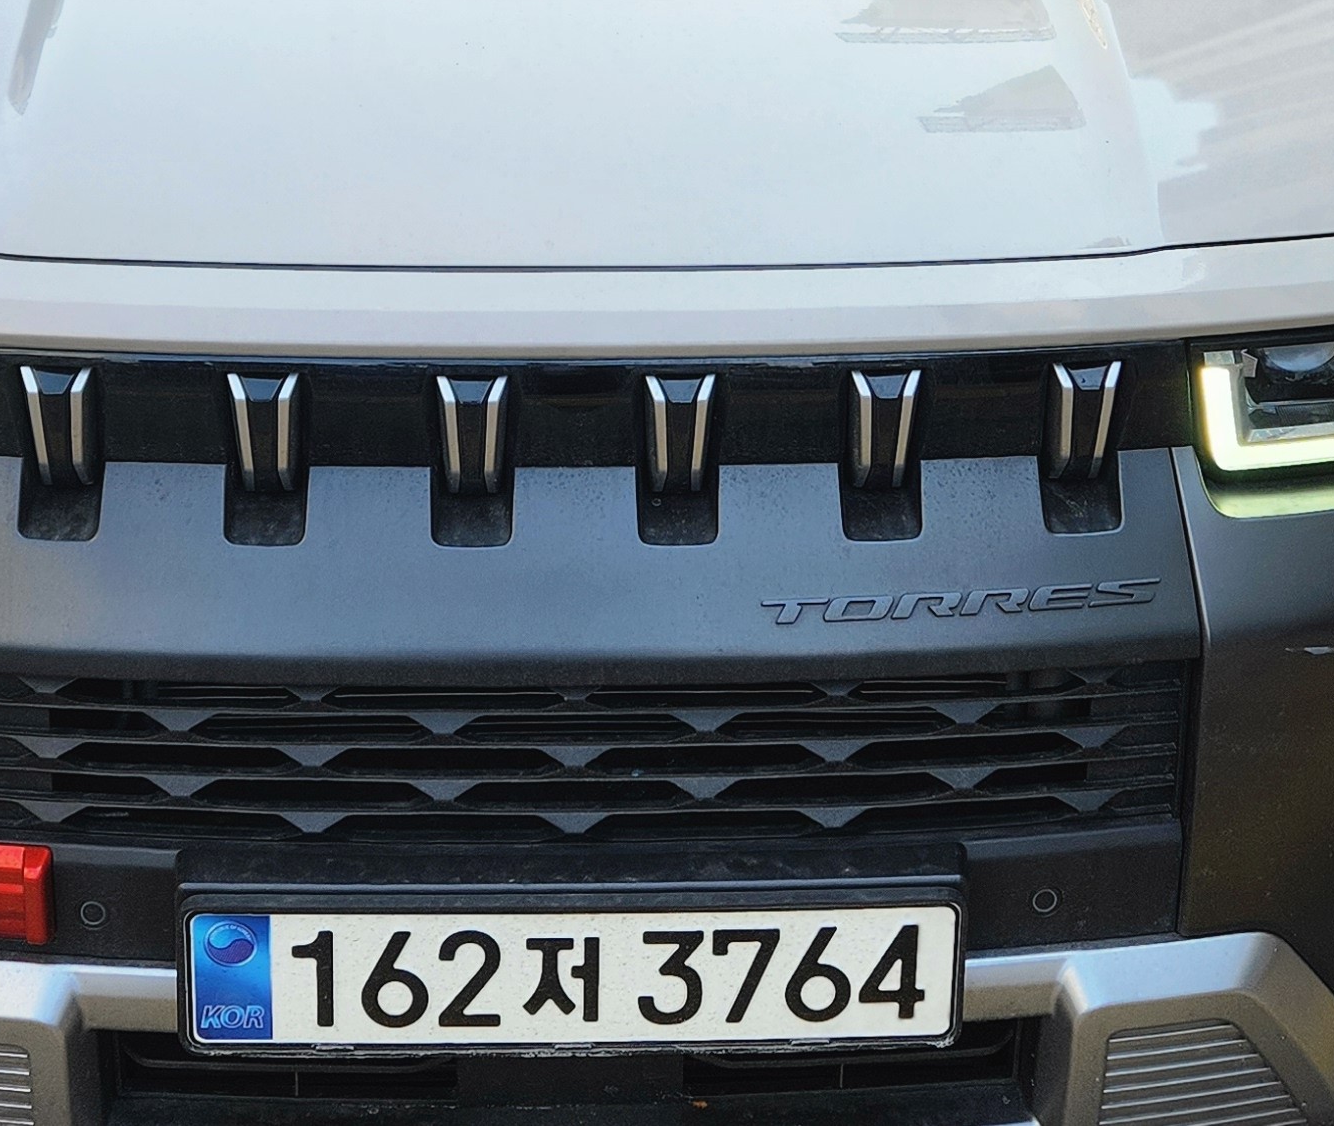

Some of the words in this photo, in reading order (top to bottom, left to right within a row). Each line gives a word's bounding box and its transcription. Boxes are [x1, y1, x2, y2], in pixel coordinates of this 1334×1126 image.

[761, 577, 1162, 625] TORRES
[292, 929, 600, 1029] 162저
[637, 924, 926, 1026] 3764
[201, 1005, 264, 1029] KOR
